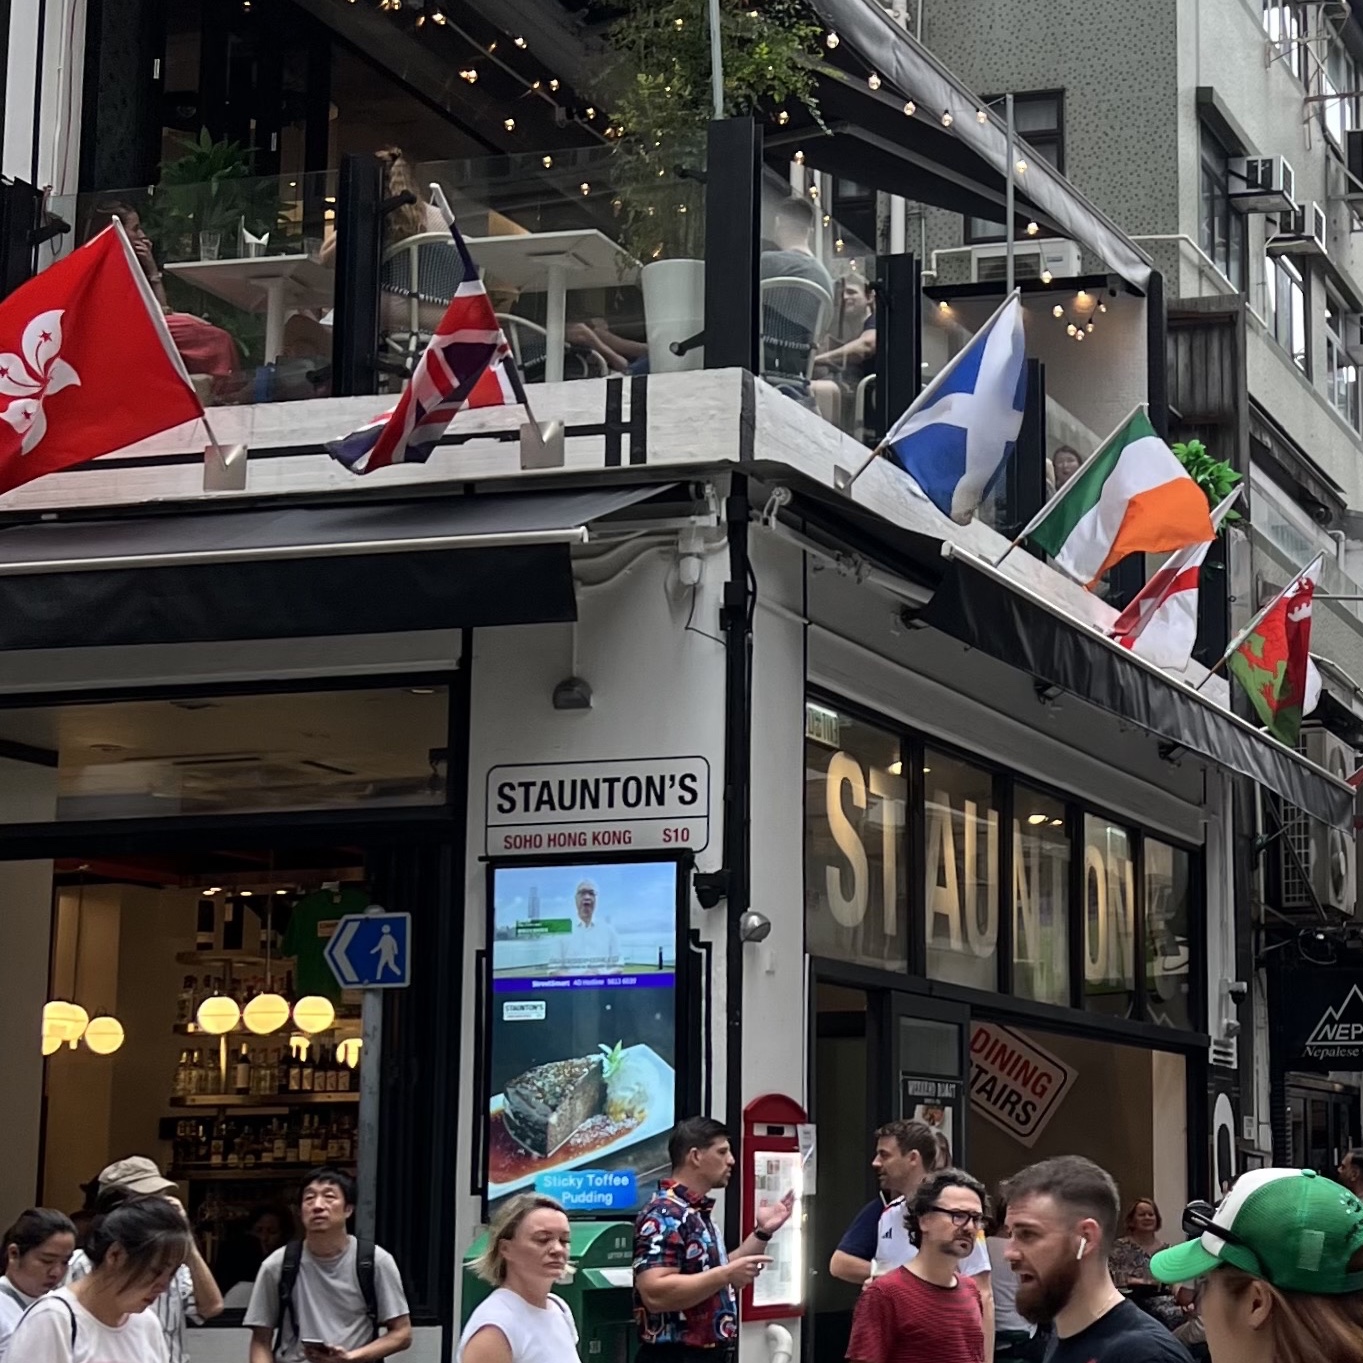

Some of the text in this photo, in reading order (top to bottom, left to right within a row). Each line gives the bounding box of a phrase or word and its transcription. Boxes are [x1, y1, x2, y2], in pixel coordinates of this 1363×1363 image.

[497, 773, 698, 814] STAUNTON'S
[504, 827, 690, 849] SOHO HONG KONG S10
[1302, 1046, 1360, 1060] Nepalese
[970, 1060, 1037, 1126] TAIRS
[544, 1173, 630, 1189] Sticky Toffee
[562, 1191, 613, 1206] Pudding
